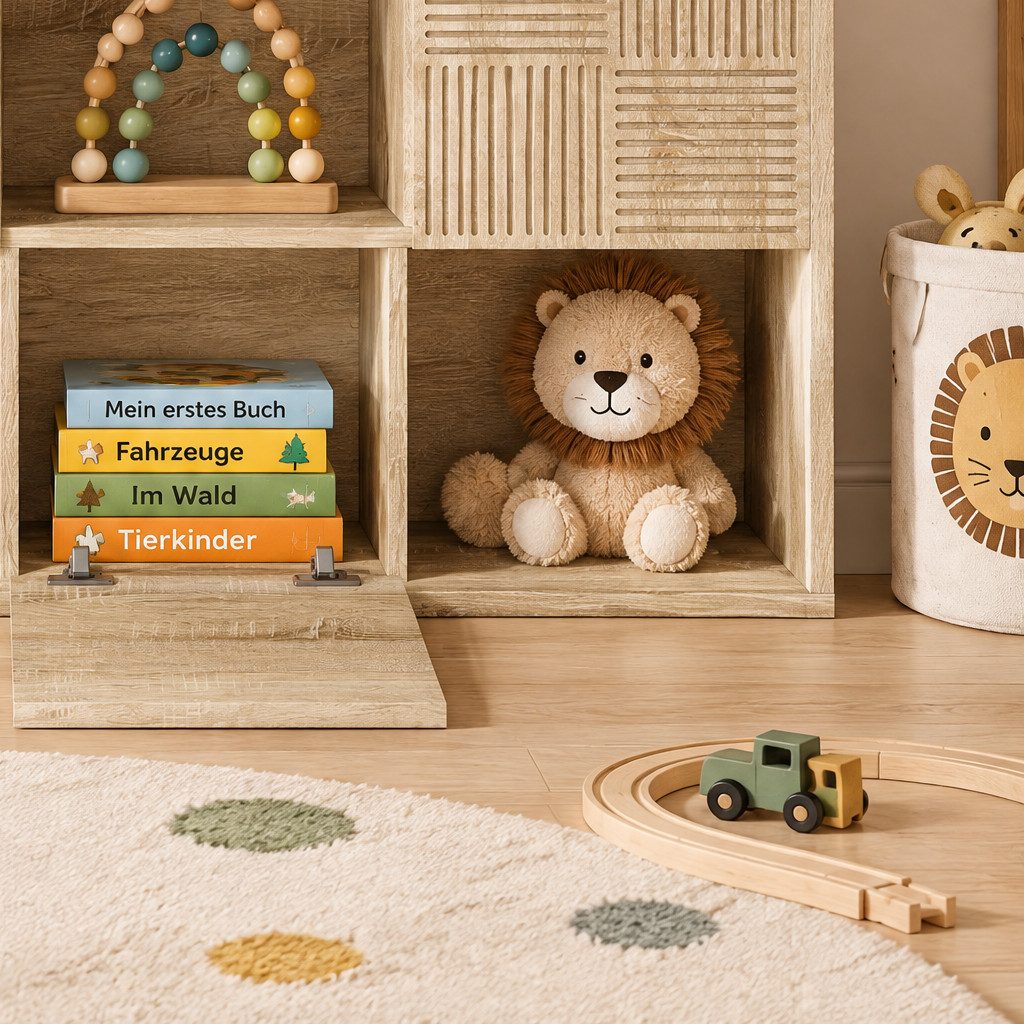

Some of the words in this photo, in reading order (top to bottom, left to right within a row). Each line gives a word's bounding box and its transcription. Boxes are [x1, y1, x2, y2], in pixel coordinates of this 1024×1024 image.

[106, 401, 155, 418] Mein
[163, 402, 226, 418] erstes
[234, 401, 285, 418] Buch
[117, 441, 243, 466] Fahrzeuge
[132, 486, 162, 504] Im
[172, 485, 236, 505] Wald
[118, 529, 257, 549] Tierkinder
